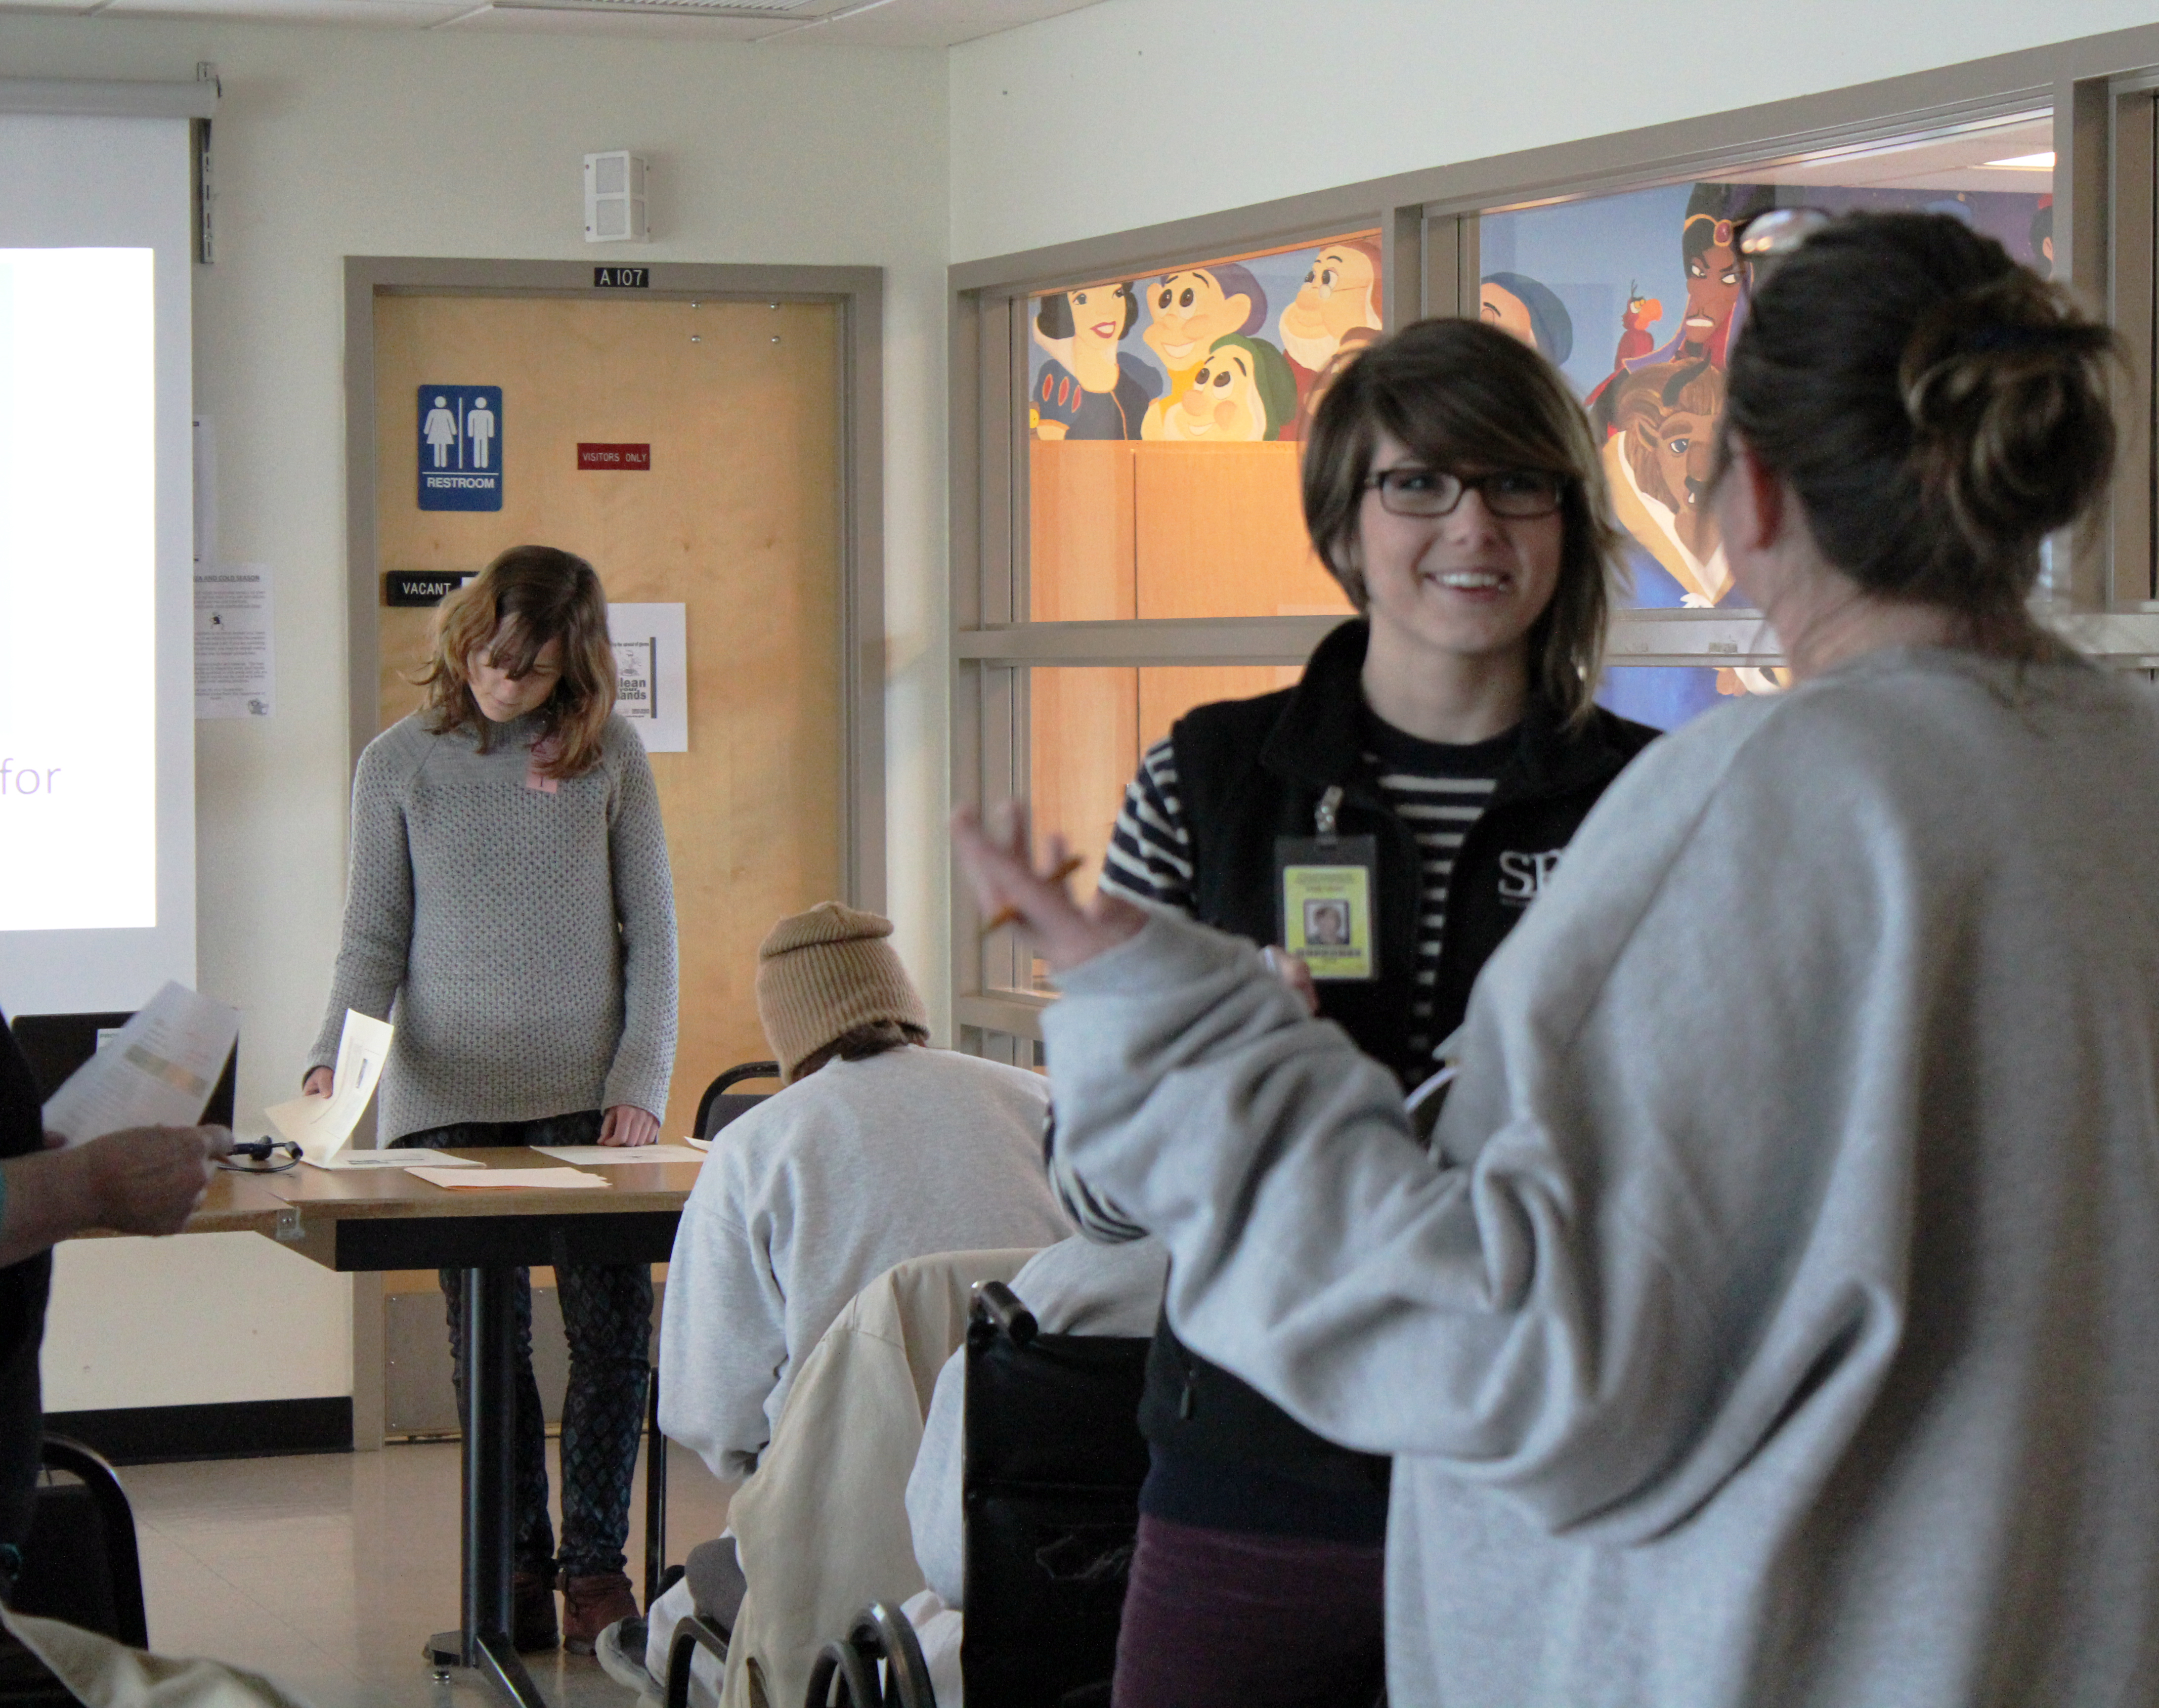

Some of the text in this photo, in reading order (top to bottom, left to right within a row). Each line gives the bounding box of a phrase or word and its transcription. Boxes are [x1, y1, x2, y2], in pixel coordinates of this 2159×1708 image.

[600, 269, 643, 286] A 107
[583, 453, 647, 462] VISITORS ONLY
[427, 477, 495, 488] RESTROOM
[402, 582, 451, 595] VACANT
[0, 758, 61, 795] for
